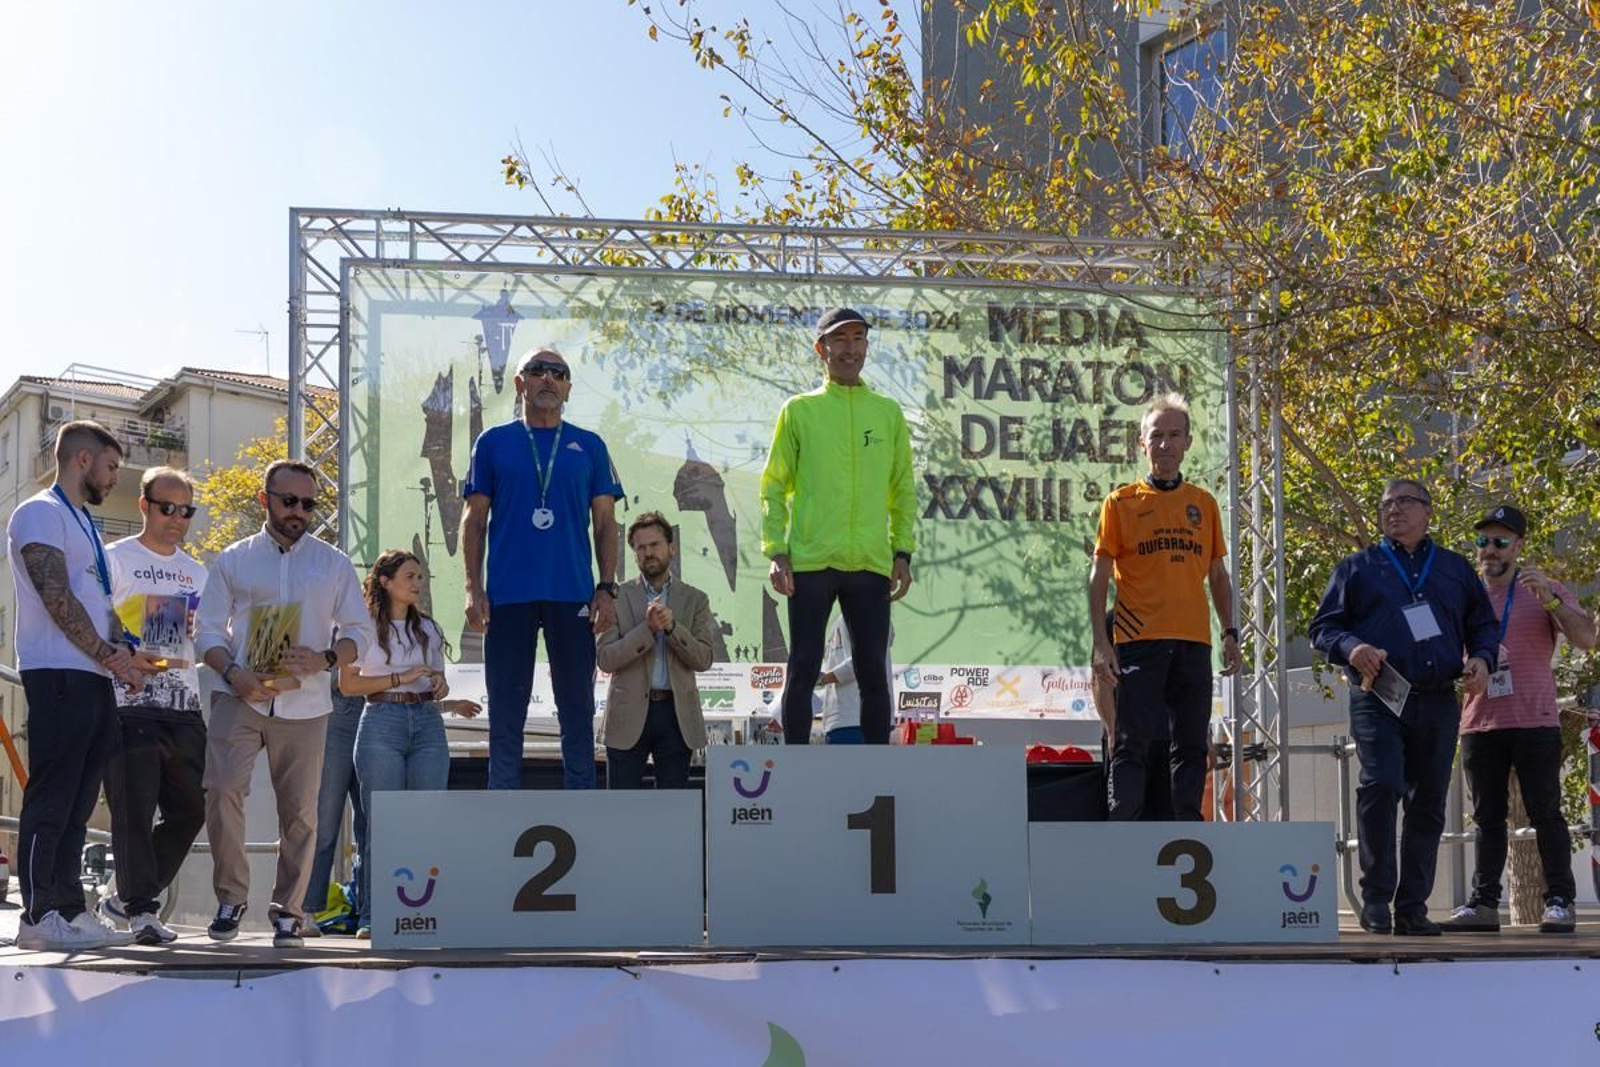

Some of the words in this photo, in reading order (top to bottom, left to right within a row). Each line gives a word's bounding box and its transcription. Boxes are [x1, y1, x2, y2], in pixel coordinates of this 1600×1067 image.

[987, 302, 1150, 348] MEDIA
[943, 348, 1191, 406] MARATÓN
[961, 414, 1026, 461] DE
[922, 474, 1073, 522] XXVIII
[134, 565, 193, 585] calderón
[950, 667, 990, 677] POWER
[967, 677, 989, 687] ADE
[900, 692, 938, 708] Luisitas
[731, 803, 773, 825] jaén
[847, 796, 896, 895] 1
[512, 824, 577, 912] 2
[1156, 839, 1217, 926] 3
[394, 911, 437, 935] jaén
[1281, 906, 1320, 928] jaén
